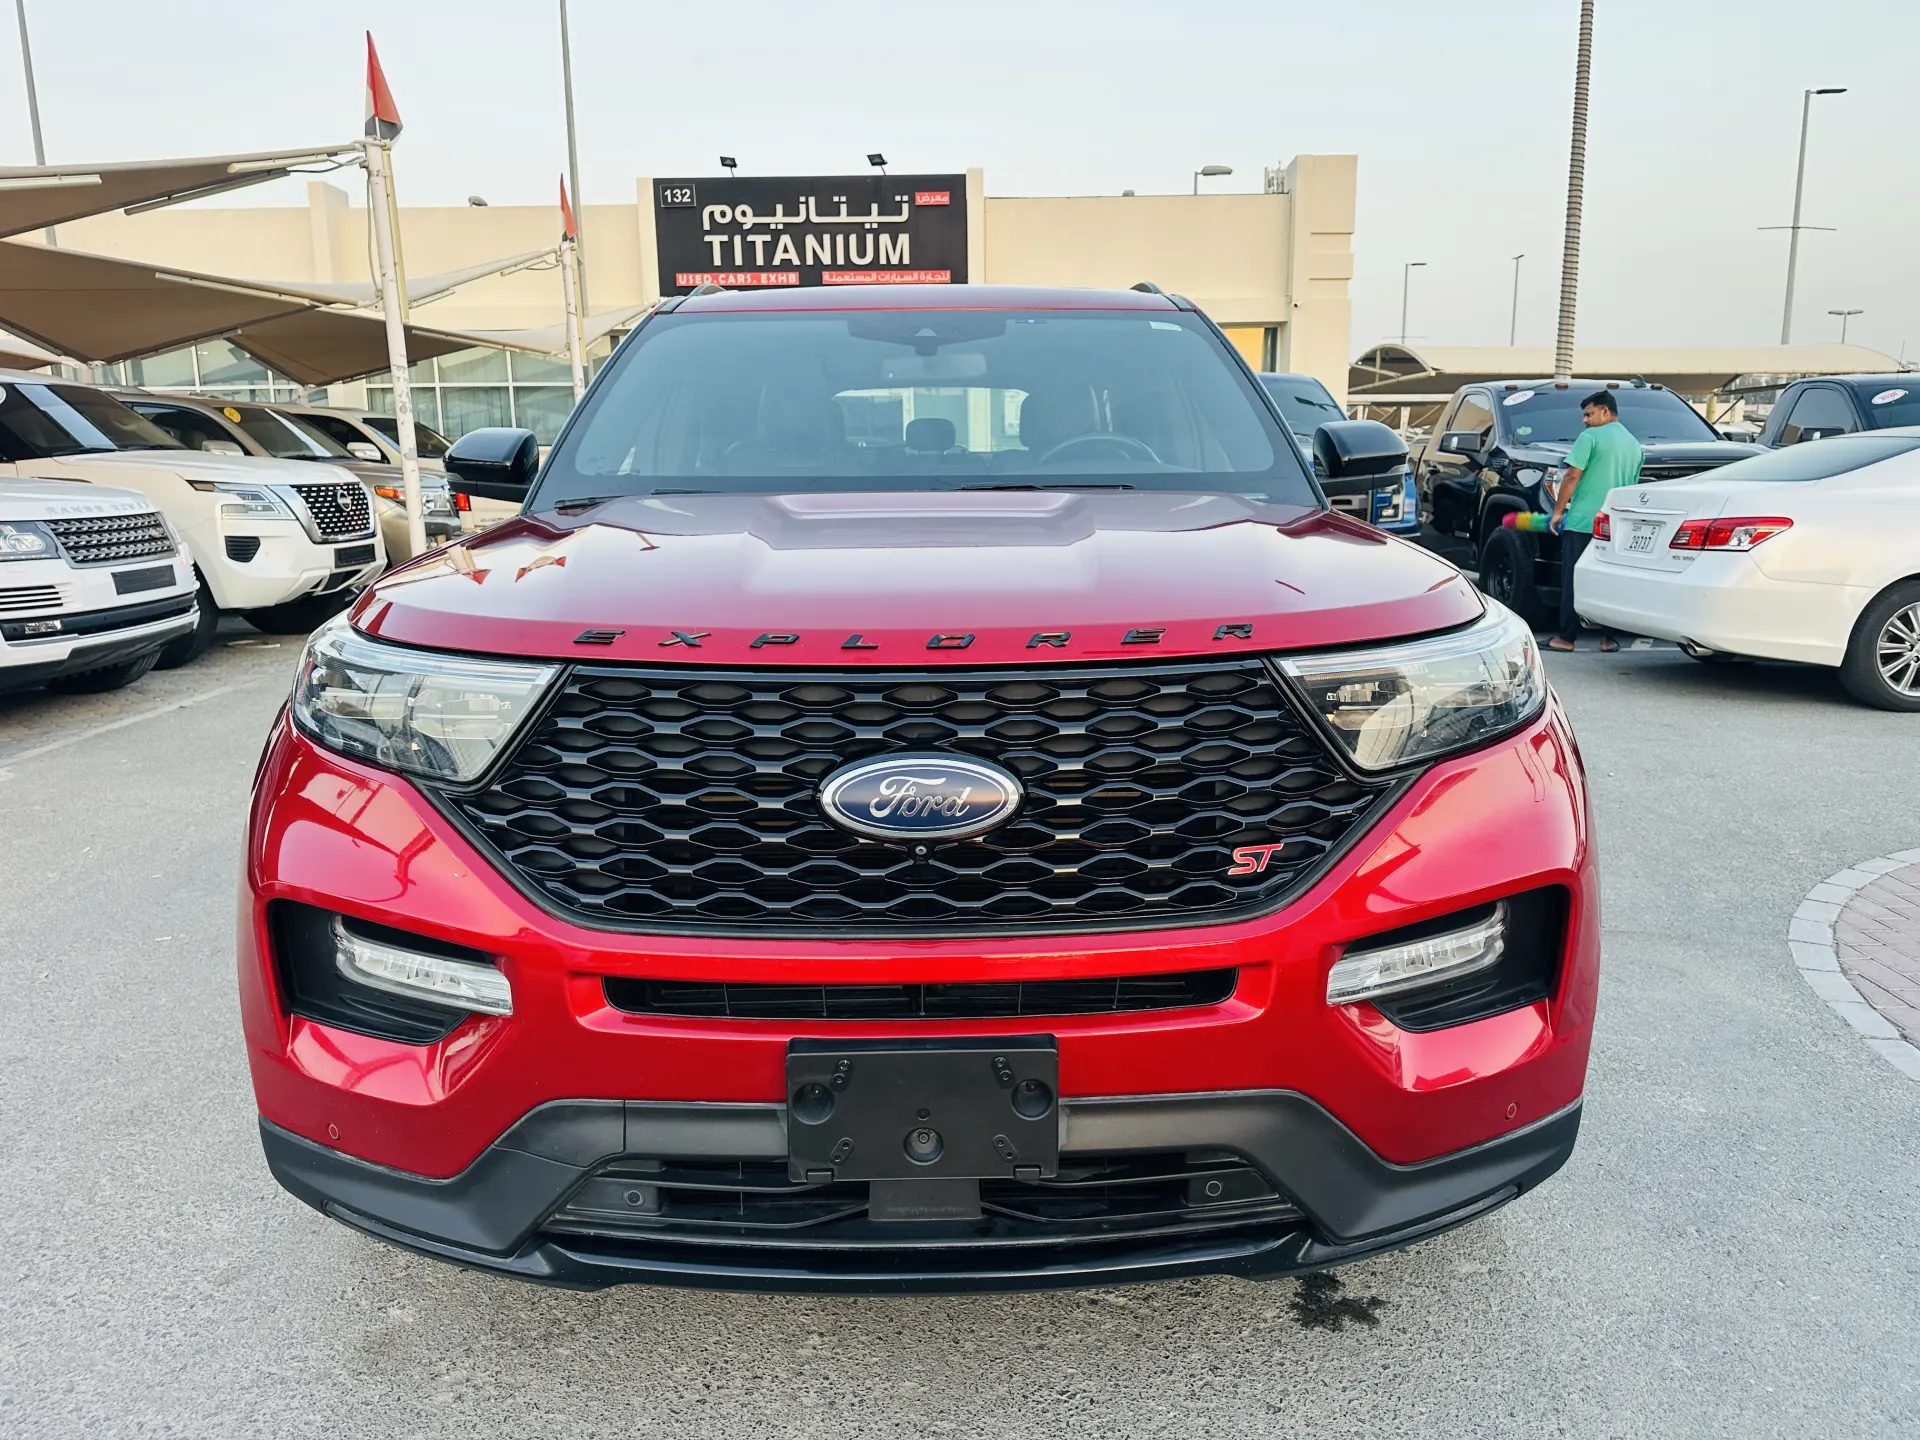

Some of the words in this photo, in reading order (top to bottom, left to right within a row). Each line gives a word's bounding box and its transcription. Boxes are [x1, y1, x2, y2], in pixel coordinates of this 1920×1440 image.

[664, 188, 692, 203] 132
[916, 192, 949, 204] معرض
[702, 194, 909, 231] تيتانيوم
[703, 233, 911, 267] TITANIUM
[760, 272, 798, 284] EXHB
[1629, 535, 1652, 550] 29737
[573, 623, 1255, 650] EXPLORER
[869, 775, 973, 818] Ford
[1228, 843, 1284, 875] ST
